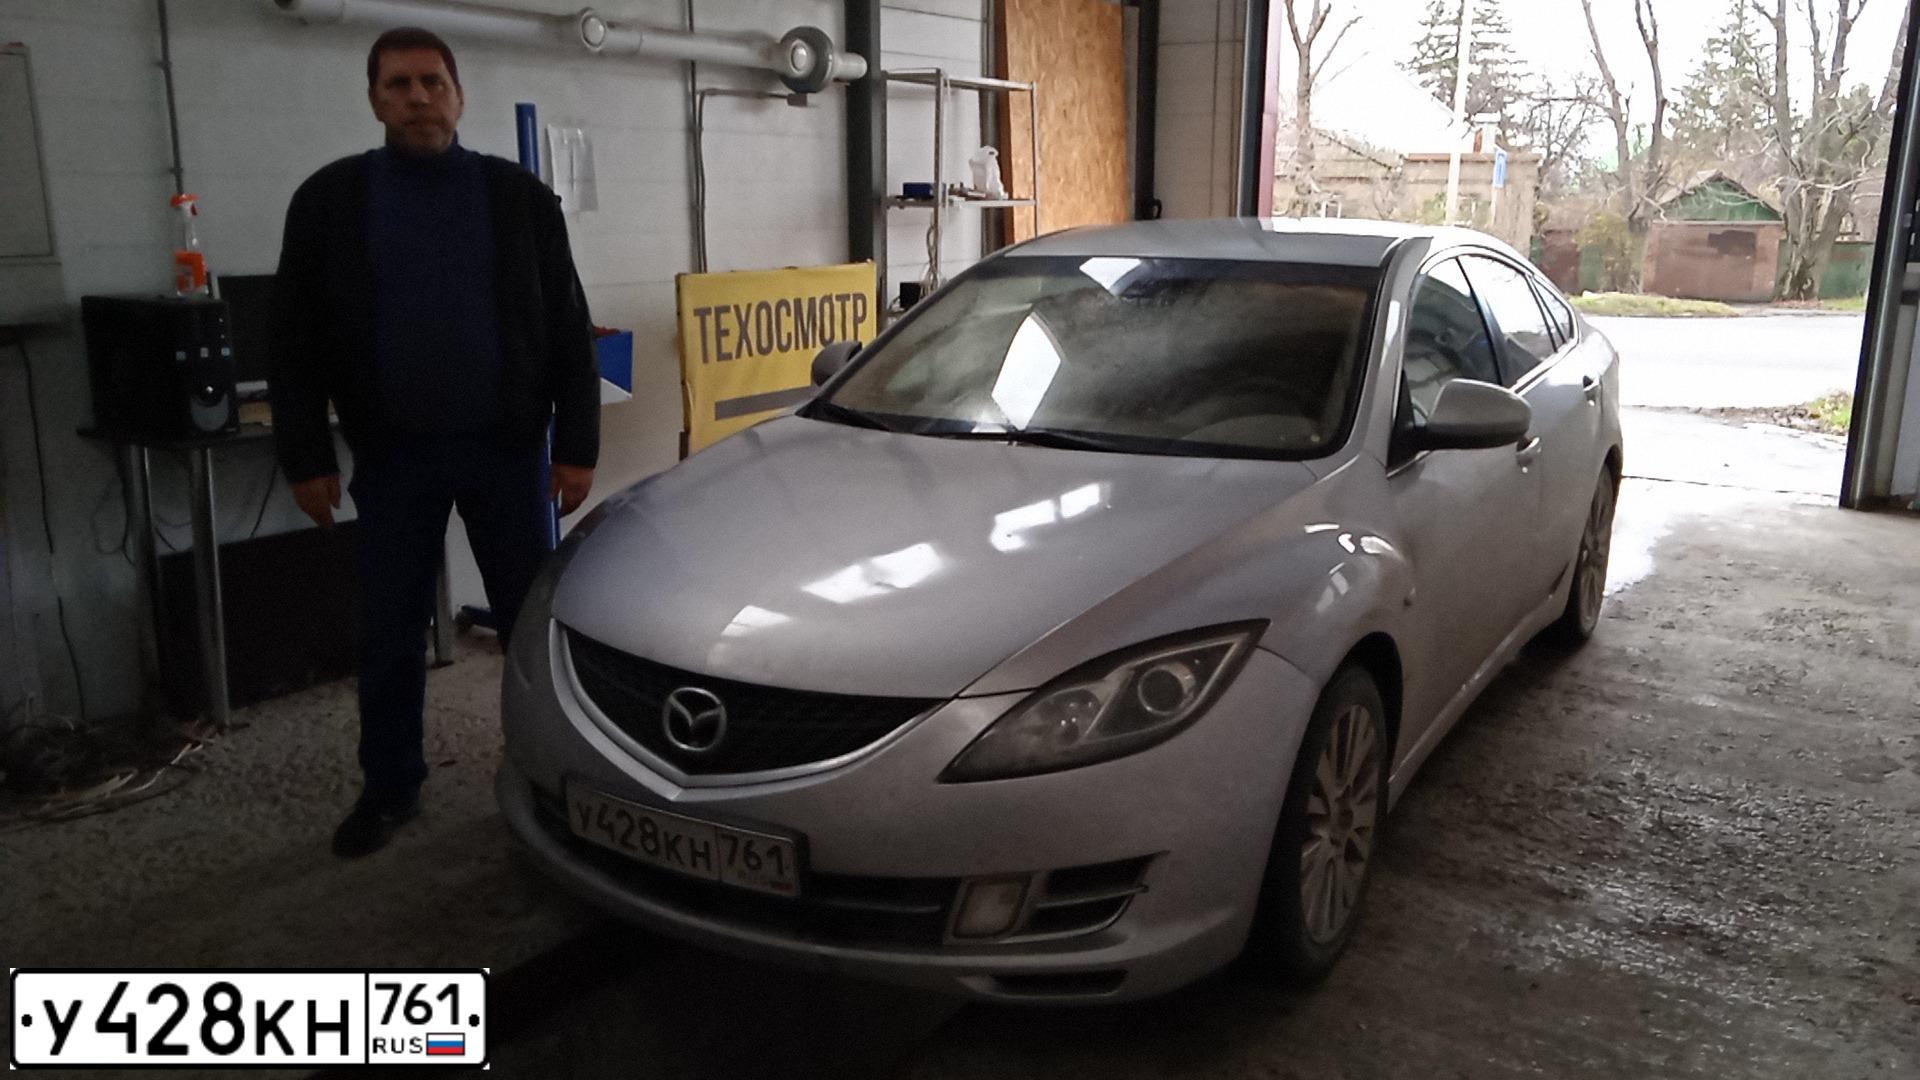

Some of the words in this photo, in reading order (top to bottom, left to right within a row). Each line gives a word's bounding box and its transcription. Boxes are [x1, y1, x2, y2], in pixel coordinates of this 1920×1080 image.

[693, 292, 868, 364] ТЕХОСМОТР
[576, 801, 712, 871] У428КН
[721, 833, 785, 875] 761
